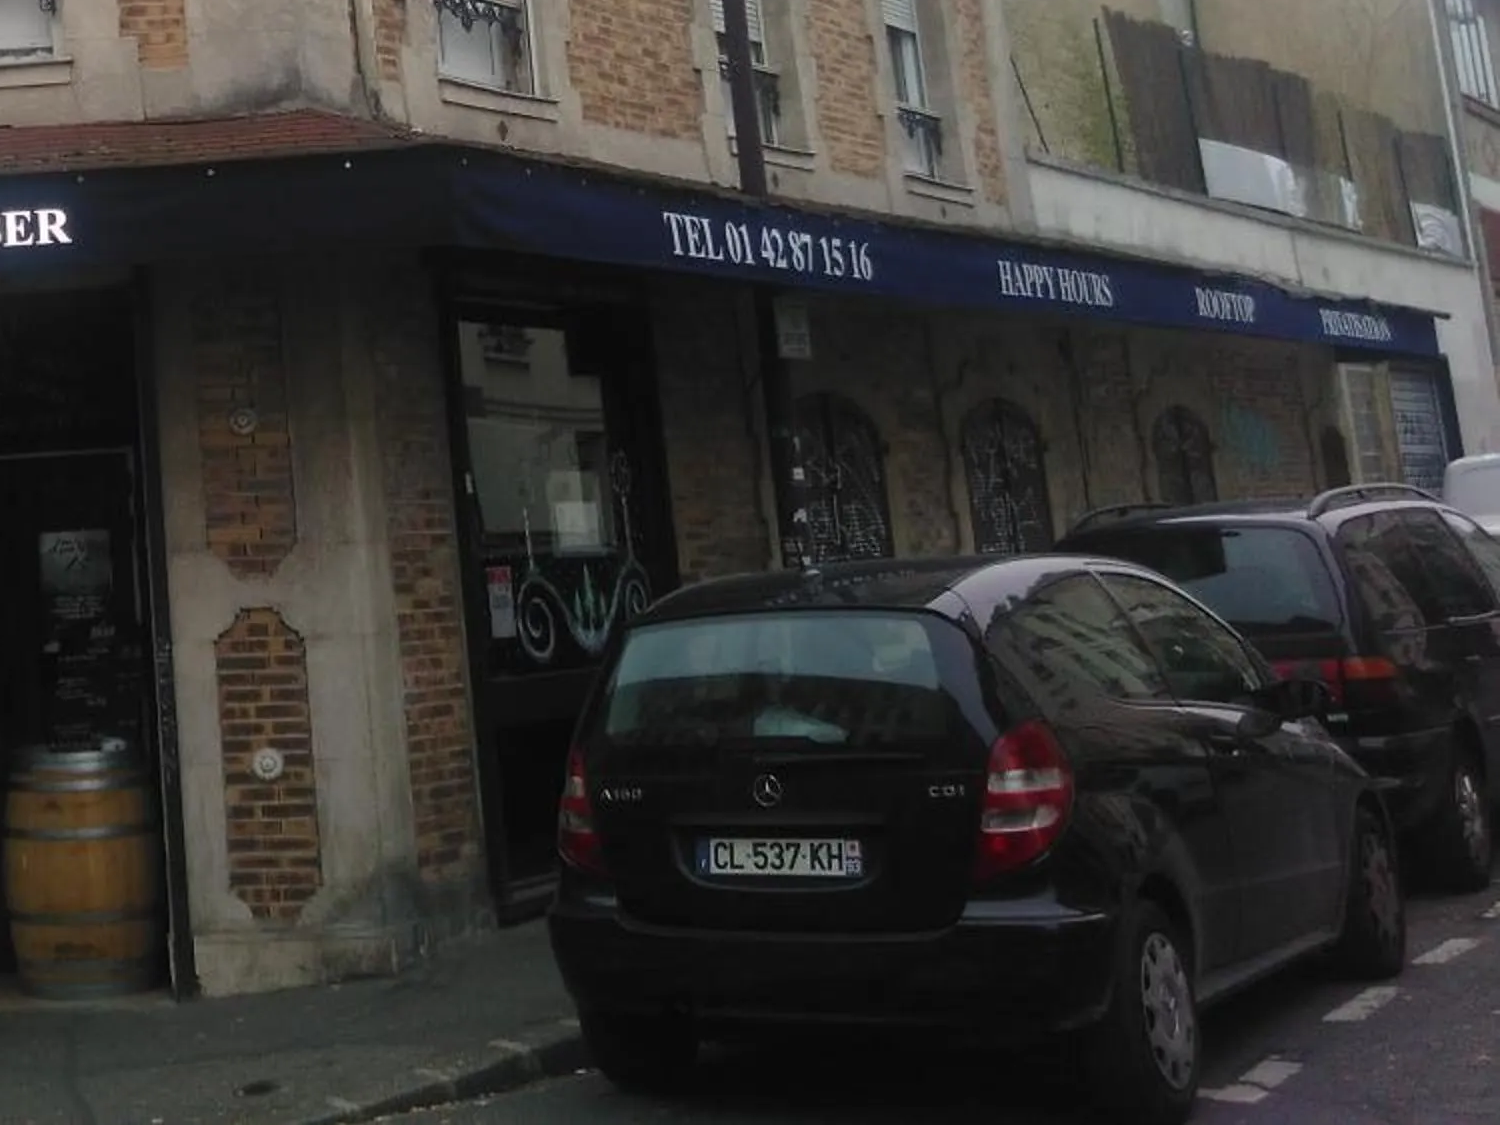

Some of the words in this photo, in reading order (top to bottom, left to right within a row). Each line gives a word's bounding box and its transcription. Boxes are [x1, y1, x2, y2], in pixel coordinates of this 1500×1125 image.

[663, 211, 724, 261] TEL
[725, 221, 756, 265] 01
[761, 226, 789, 269] 42
[788, 230, 813, 272] 87
[819, 236, 845, 277] 15
[848, 240, 873, 281] 16
[997, 260, 1056, 300] HAPPY
[1057, 268, 1113, 307] HOURS
[1194, 286, 1255, 324] ROOFTOP
[928, 784, 965, 798] CDI
